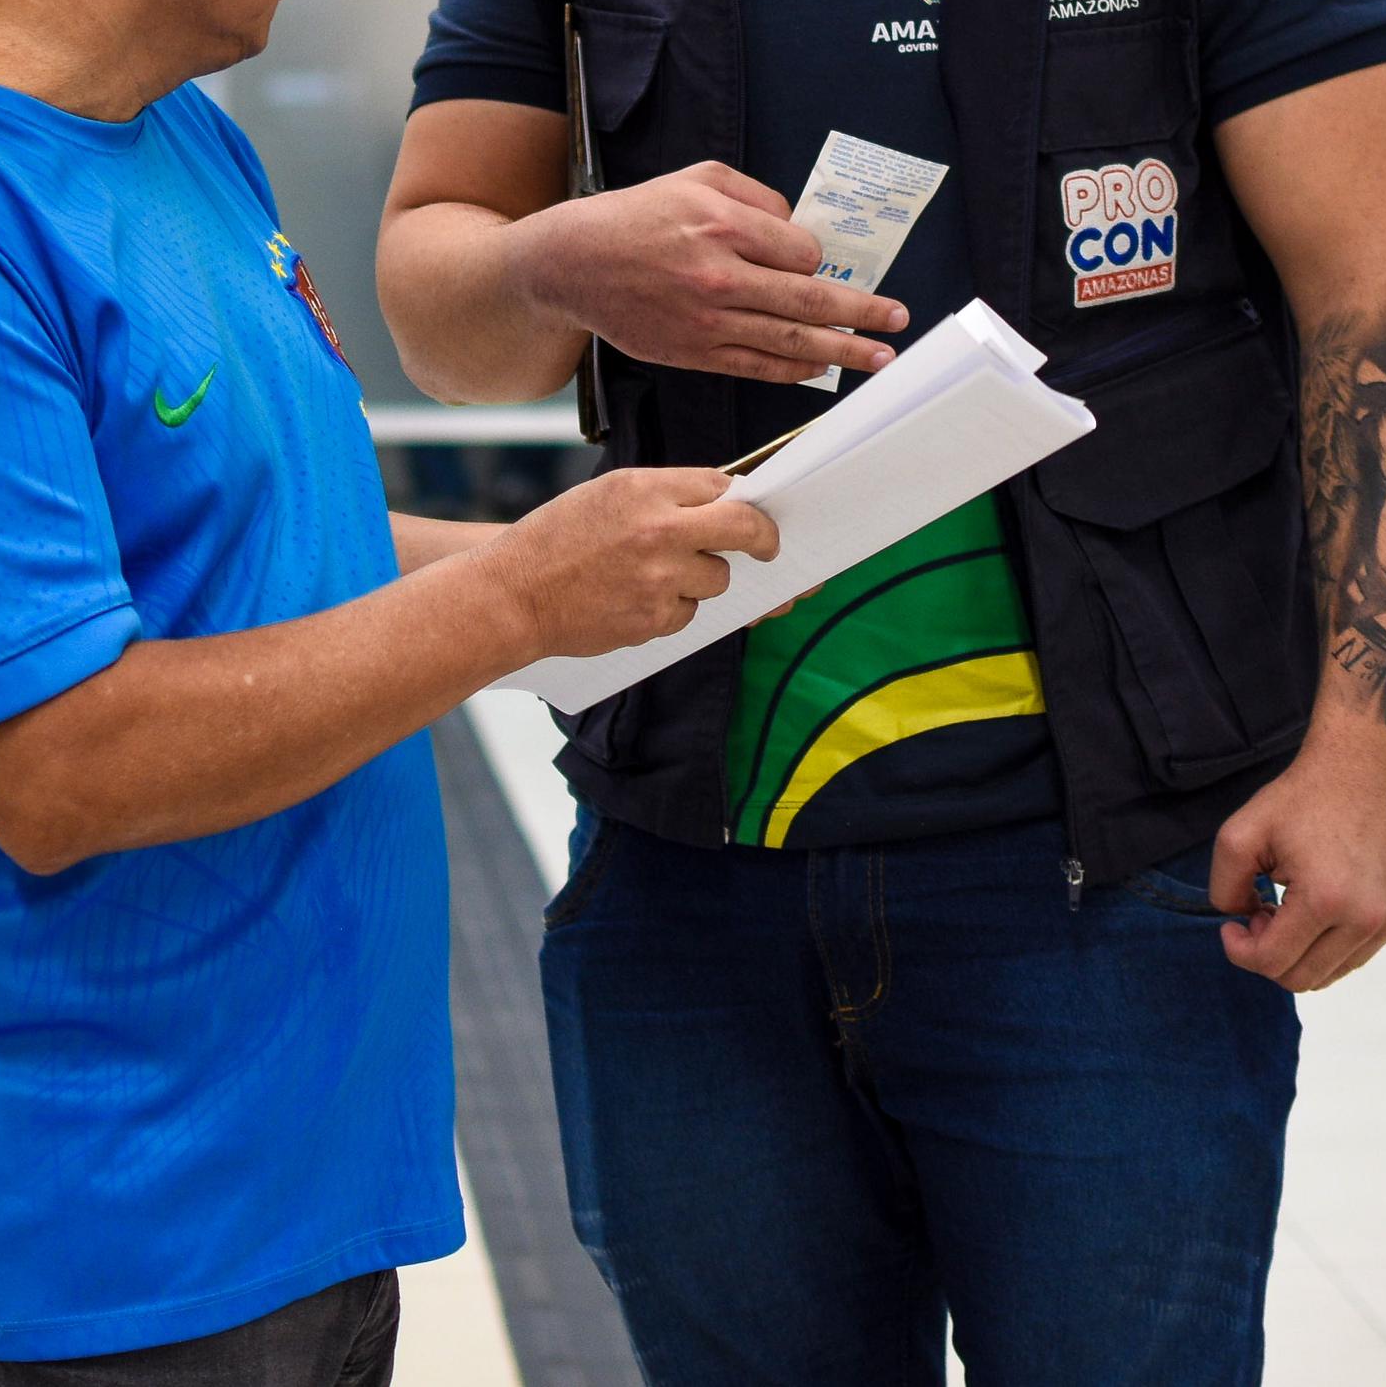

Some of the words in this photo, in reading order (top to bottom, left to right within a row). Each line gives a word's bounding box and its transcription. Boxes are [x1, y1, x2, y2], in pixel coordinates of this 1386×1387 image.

[871, 19, 940, 43] AMA
[1064, 162, 1175, 227] PRO
[1070, 215, 1174, 271] CON
[1080, 266, 1169, 298] AMAZONAS
